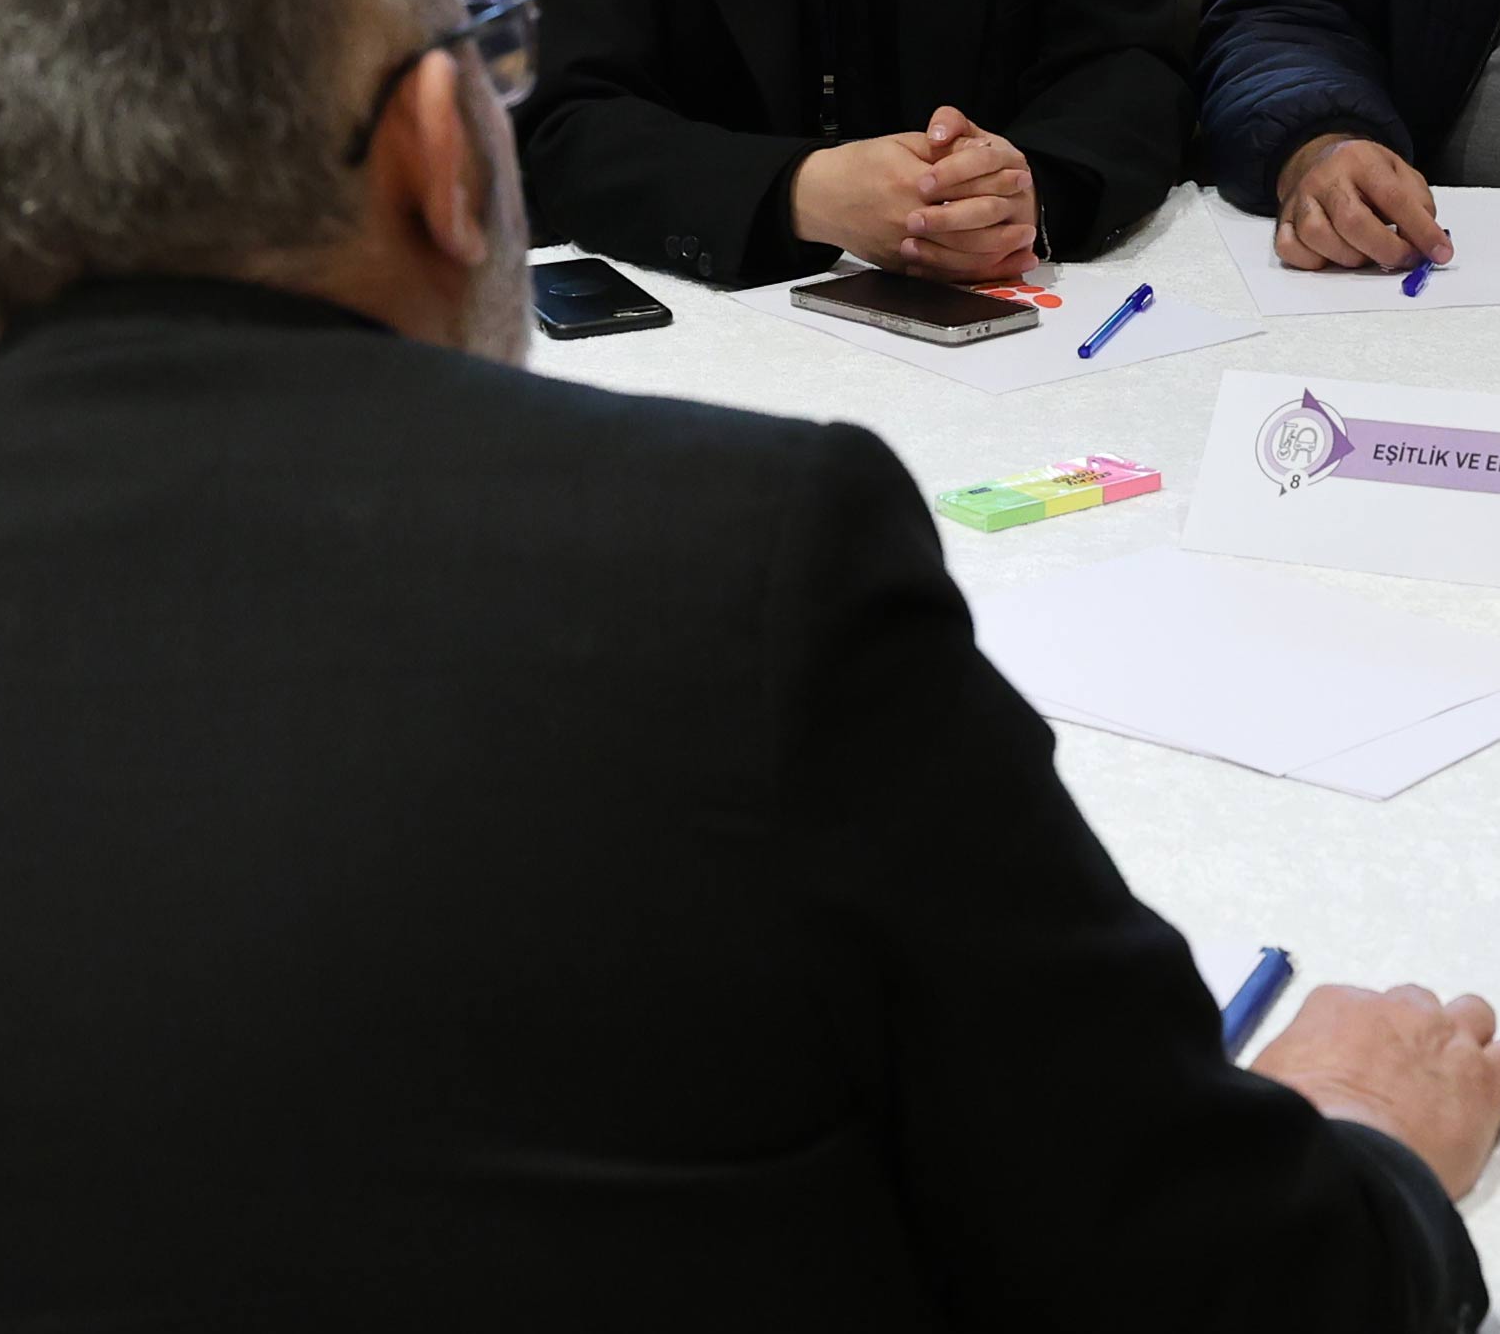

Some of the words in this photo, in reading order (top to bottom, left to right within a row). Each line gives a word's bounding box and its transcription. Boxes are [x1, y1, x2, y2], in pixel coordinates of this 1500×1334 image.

[1373, 441, 1449, 468] EŞİTLİK
[1455, 451, 1481, 470] VE
[1289, 474, 1301, 490] 8
